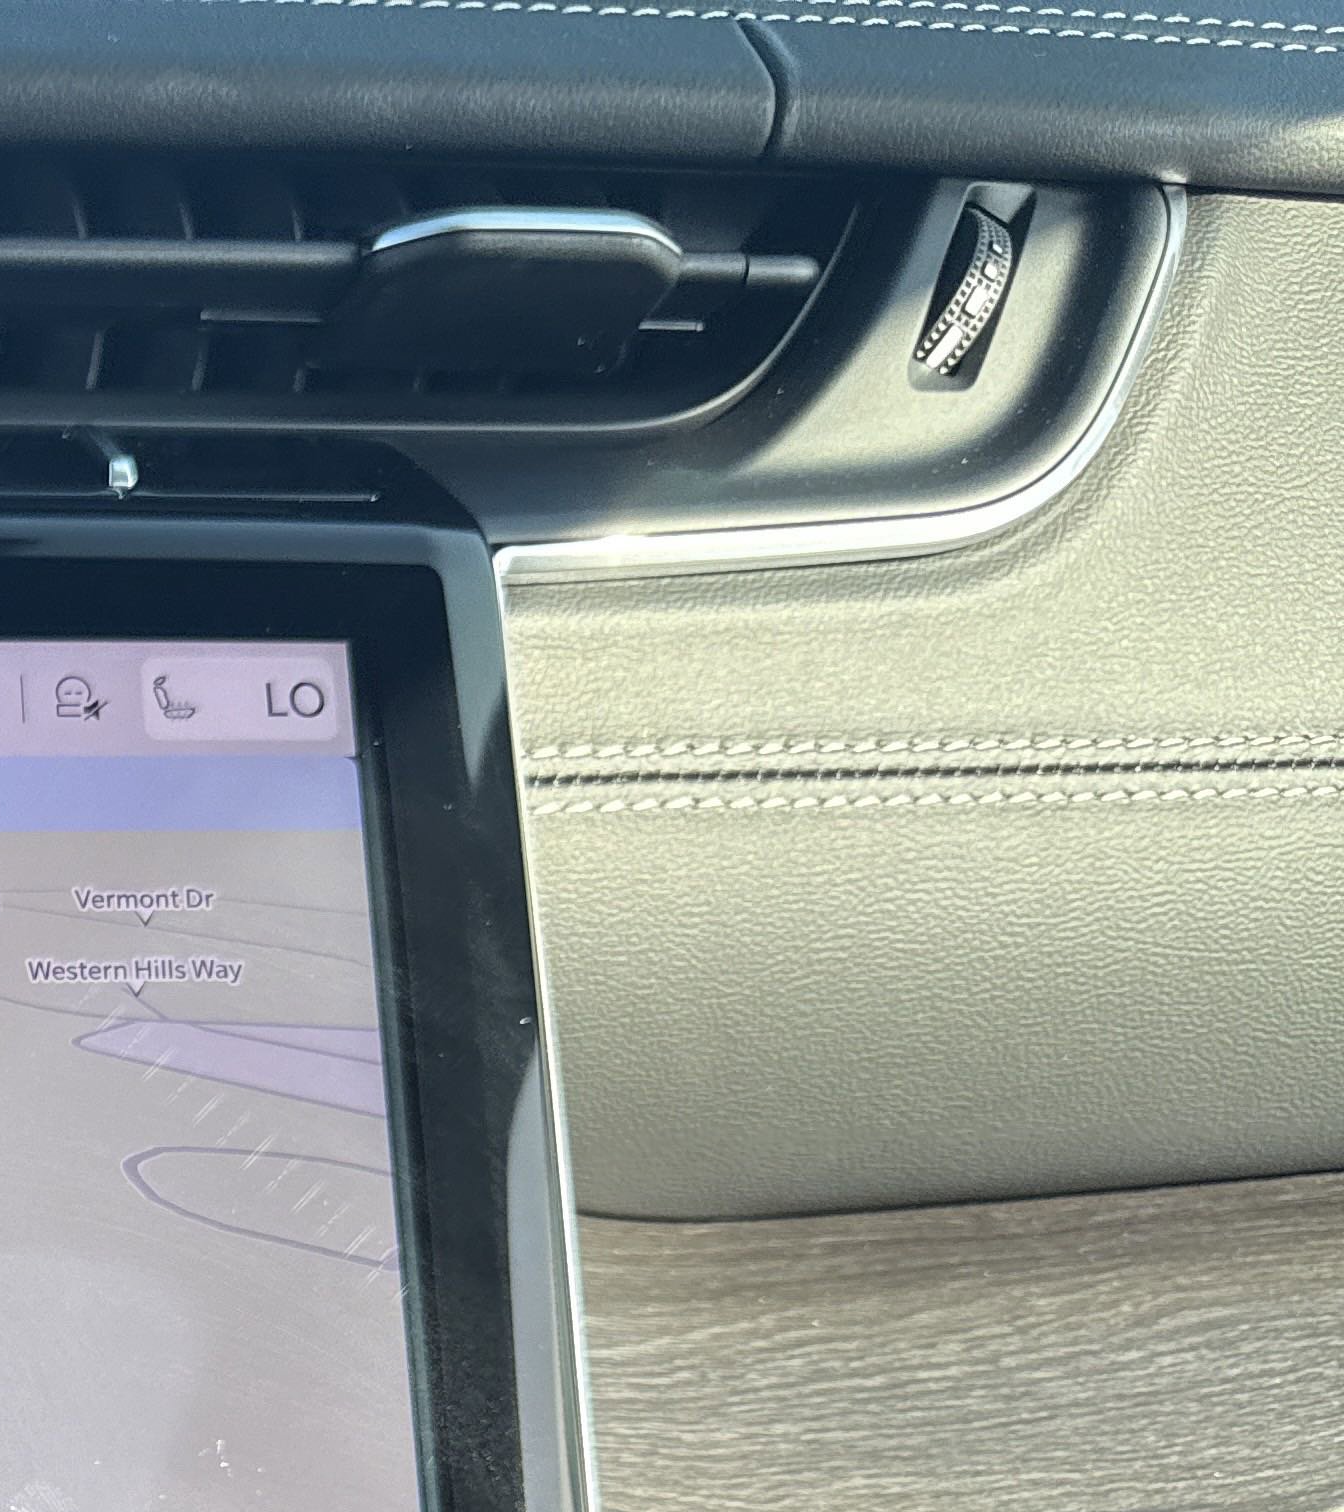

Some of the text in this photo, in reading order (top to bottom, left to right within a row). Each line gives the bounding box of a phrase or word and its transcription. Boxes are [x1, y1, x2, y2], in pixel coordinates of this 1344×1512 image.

[265, 681, 325, 718] LO
[74, 888, 214, 910] Vermont Dr
[28, 960, 243, 985] Western Hills Way
